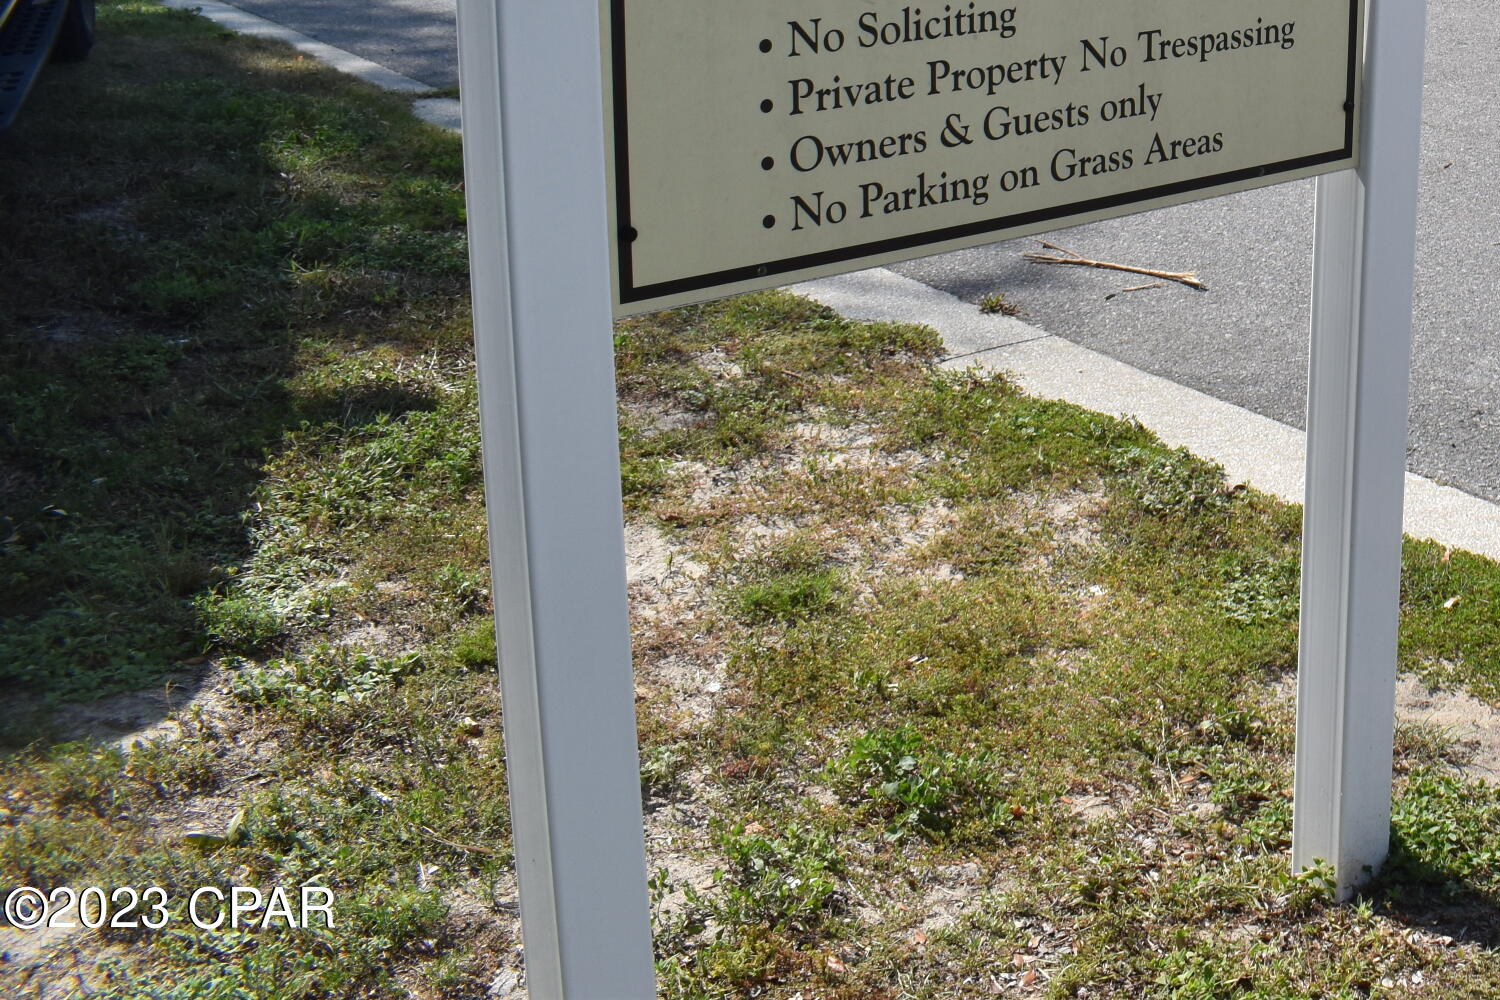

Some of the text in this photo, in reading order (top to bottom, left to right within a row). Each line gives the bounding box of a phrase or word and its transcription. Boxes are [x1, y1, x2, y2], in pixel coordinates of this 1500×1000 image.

[787, 2, 1016, 57] No Soliciting
[787, 17, 1295, 116] Private Property No Trespassing
[790, 82, 1163, 172] Owners & Guests only
[790, 132, 1223, 231] No Parking on Grass Areas
